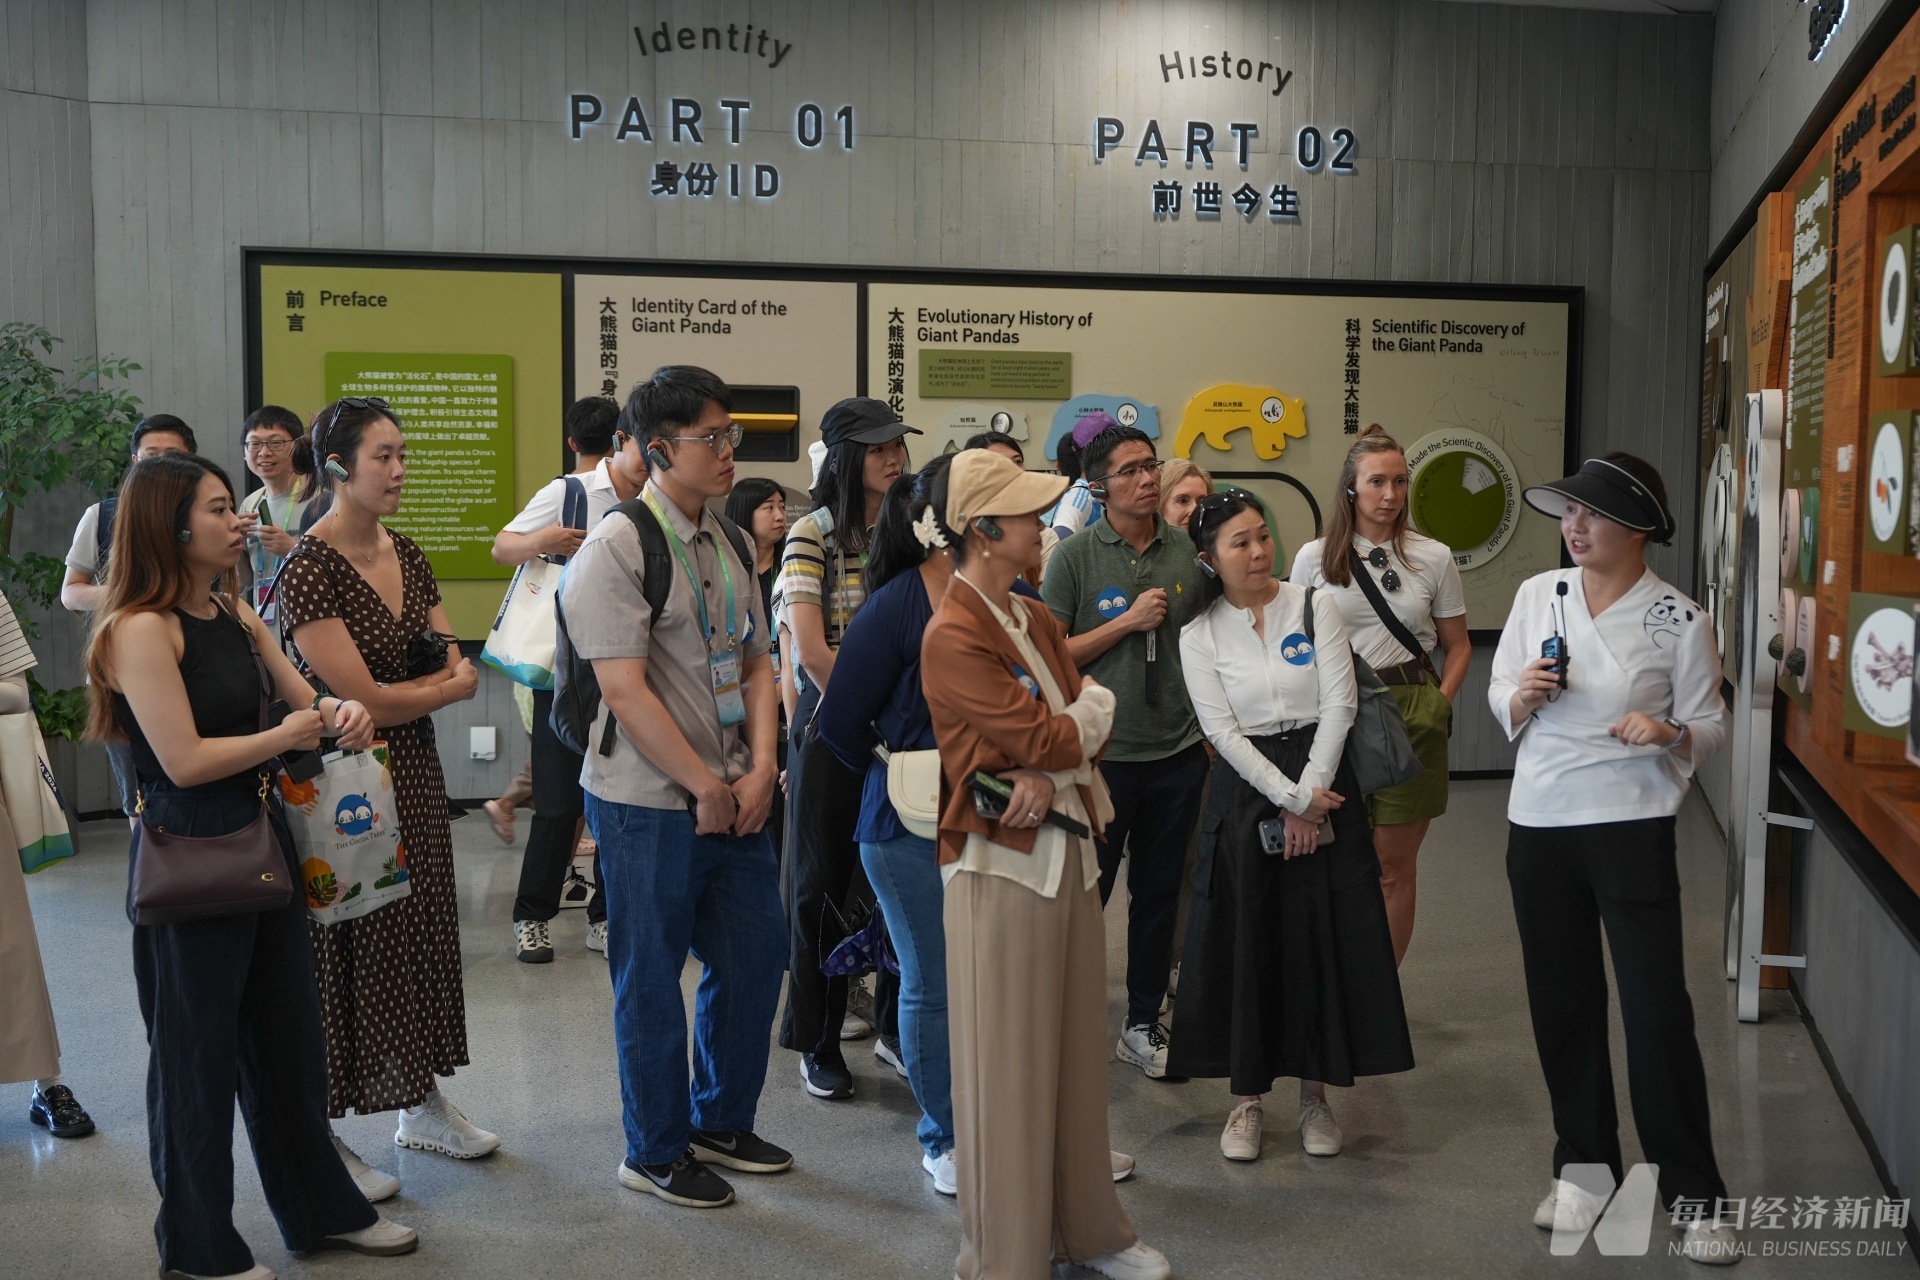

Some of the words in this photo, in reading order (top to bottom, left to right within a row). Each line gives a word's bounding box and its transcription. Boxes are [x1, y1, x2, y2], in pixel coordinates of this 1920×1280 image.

[633, 21, 793, 69] Identity
[1159, 50, 1293, 96] History
[570, 94, 751, 144] PART
[797, 103, 853, 149] 01
[1096, 117, 1258, 165] PART
[1297, 126, 1355, 170] 02
[1152, 179, 1299, 216] 前世今生
[319, 290, 388, 308] Preface
[631, 297, 694, 318] Identity
[698, 298, 737, 315] Card
[741, 300, 758, 315] of
[760, 300, 788, 316] the
[285, 289, 305, 333] 前言
[917, 307, 1016, 328] Evolutionary
[1019, 310, 1075, 330] History
[1078, 312, 1093, 327] of
[631, 317, 675, 334] Giant
[680, 318, 732, 335] Panda
[917, 326, 959, 343] Giant
[963, 328, 1020, 344] Pandas
[1372, 318, 1438, 335] Scientific
[1440, 319, 1509, 339] Discovery
[1511, 321, 1526, 336] of
[1371, 336, 1395, 351] the
[1399, 337, 1436, 353] Giant
[1439, 338, 1483, 354] Panda
[1343, 317, 1361, 436] 科学发现大熊猫
[1427, 442, 1442, 453] the
[1442, 437, 1475, 449] Scientic
[1408, 449, 1429, 470] Made
[1475, 441, 1506, 474] Discovery
[1502, 473, 1512, 483] of
[1505, 483, 1514, 498] the
[1506, 499, 1515, 524] Giant
[1487, 525, 1510, 553] Panda?
[44, 771, 57, 792] 2026
